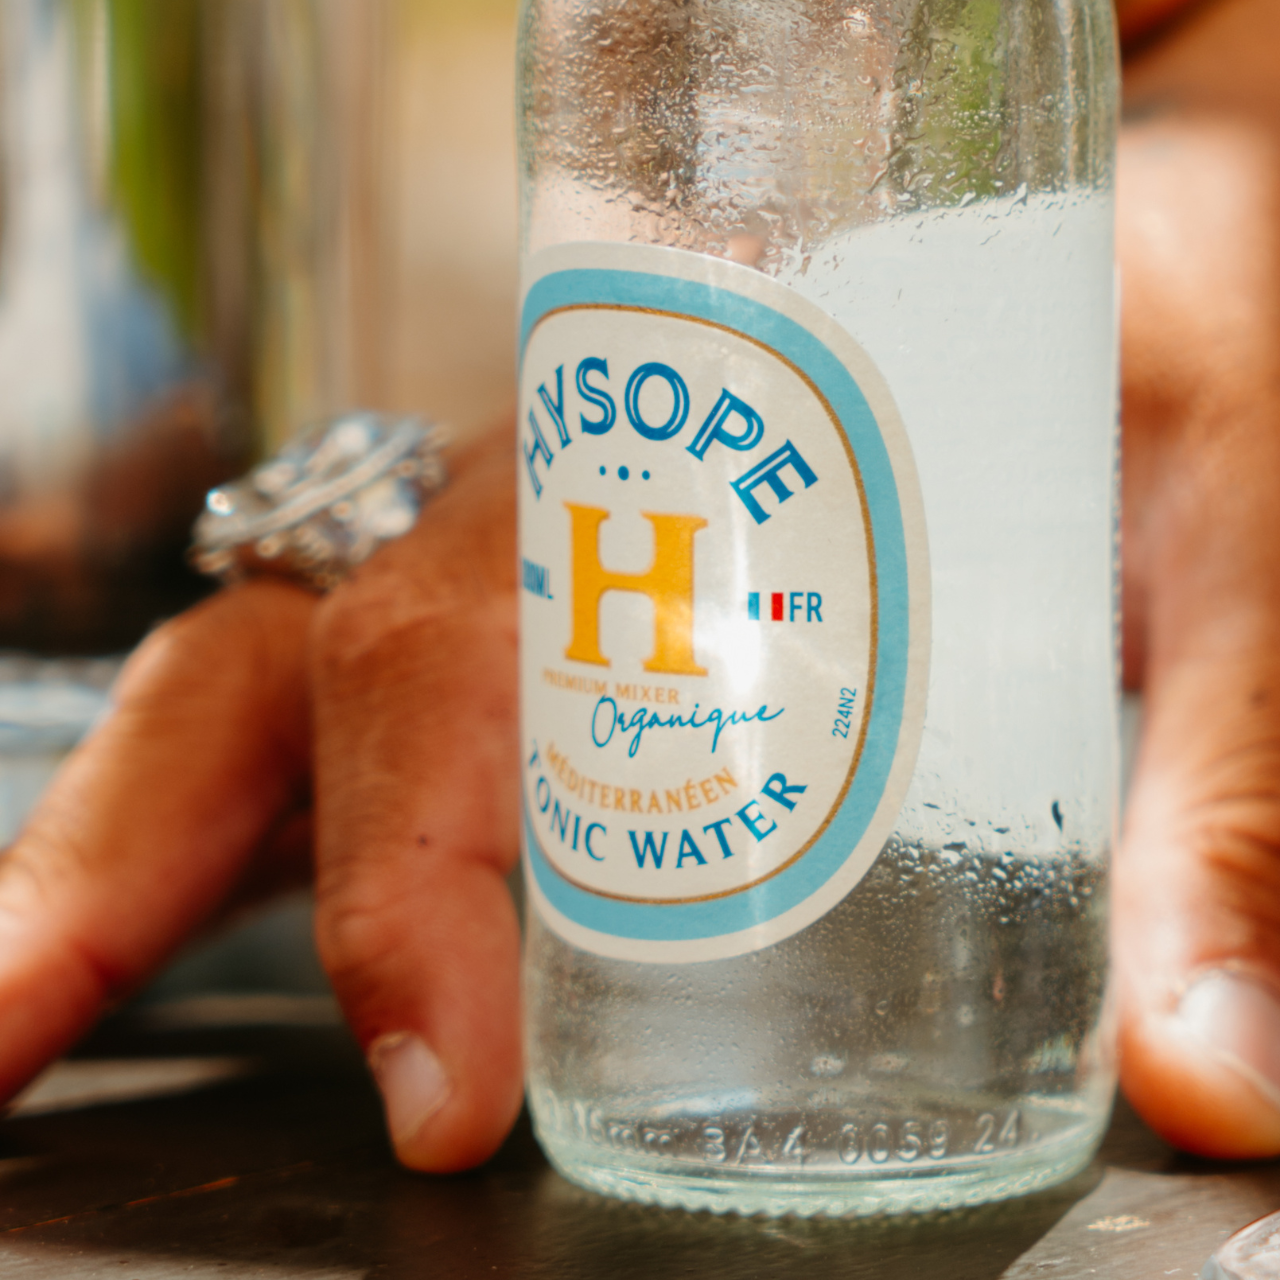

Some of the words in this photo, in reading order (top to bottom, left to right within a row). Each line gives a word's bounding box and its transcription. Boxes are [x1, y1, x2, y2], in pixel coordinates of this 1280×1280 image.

[523, 357, 819, 525] HYSOPE
[562, 500, 708, 677] H
[789, 592, 823, 622] FR
[542, 667, 608, 695] PREMIUM
[615, 682, 680, 705] MIXER
[832, 687, 857, 739] 224N2
[591, 694, 785, 758] Organique
[529, 738, 607, 861] TONIC
[627, 772, 808, 869] WATER
[545, 741, 738, 815] MÉDITERRANÉEN
